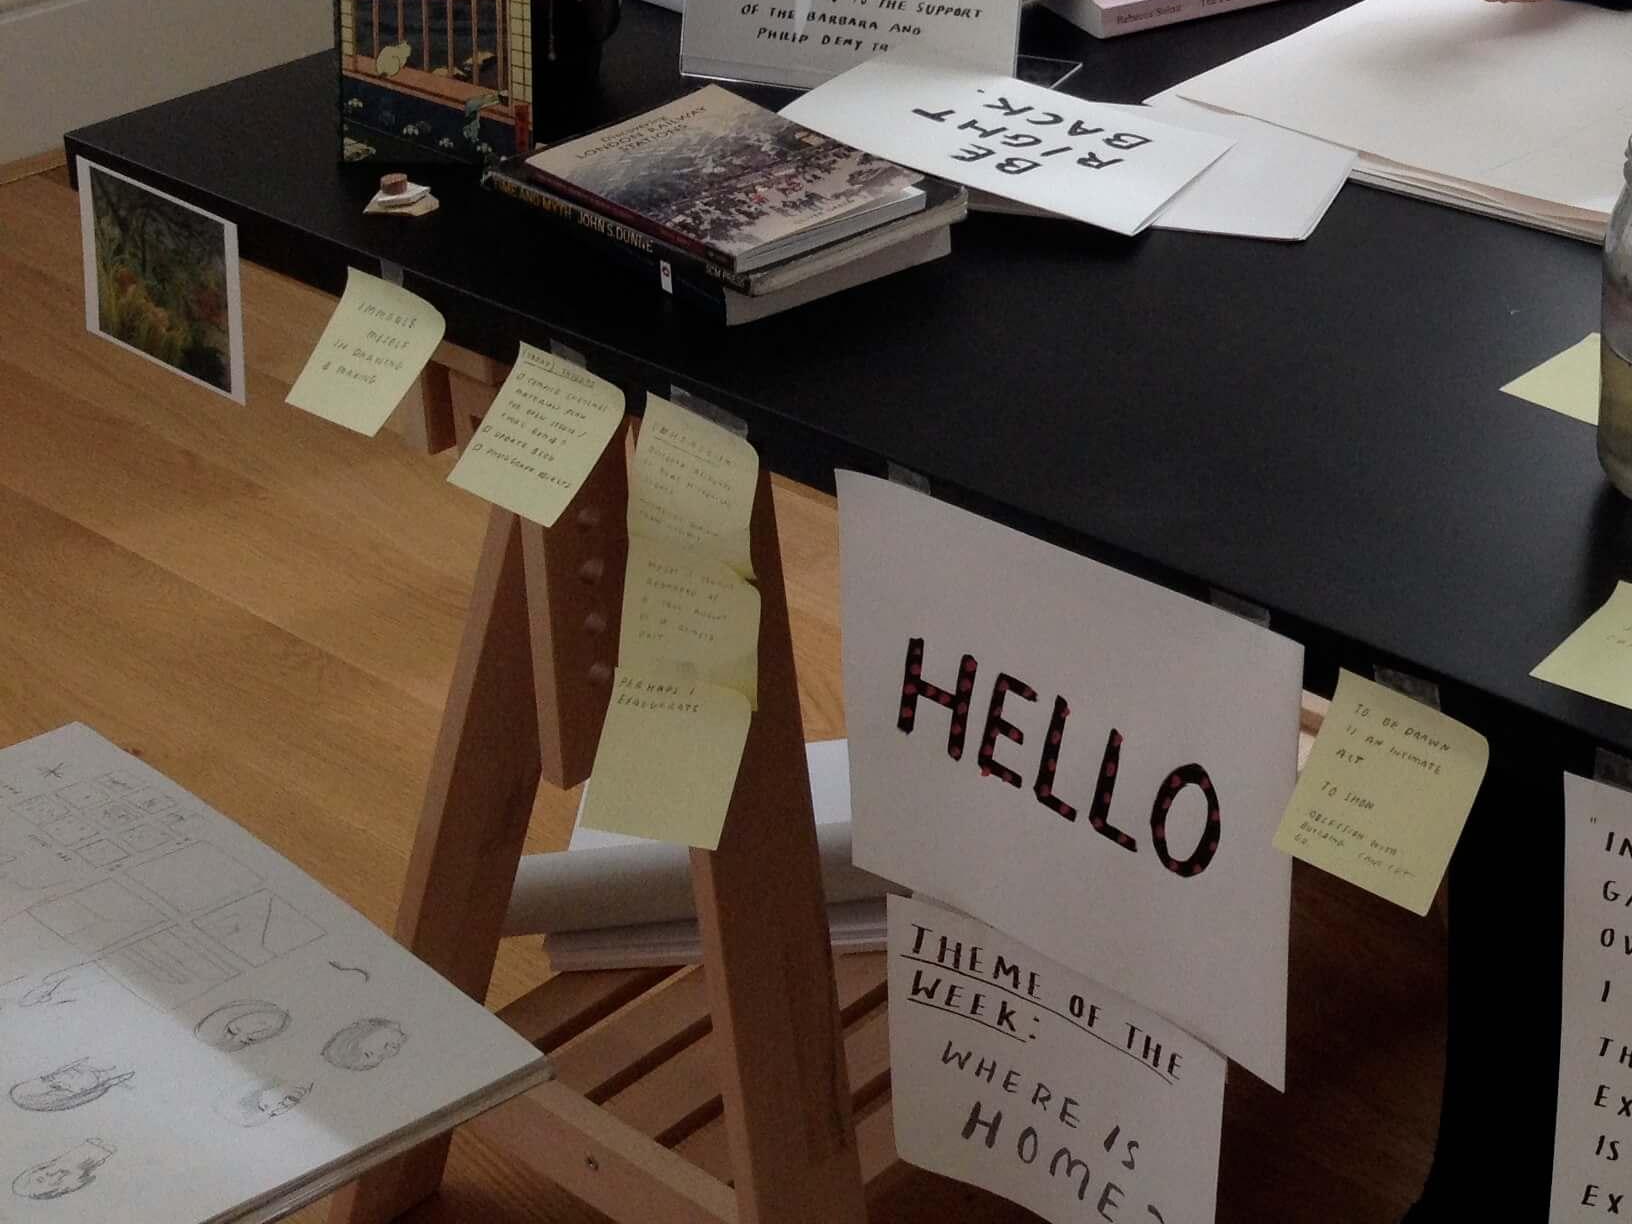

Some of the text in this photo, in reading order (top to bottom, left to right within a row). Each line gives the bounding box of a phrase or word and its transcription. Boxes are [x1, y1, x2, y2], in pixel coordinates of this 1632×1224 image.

[741, 4, 760, 16] OF
[769, 7, 796, 20] THE
[888, 23, 922, 36] AND
[916, 1, 984, 20] SUPPORT
[757, 27, 809, 43] PHILIP
[576, 130, 647, 160] LONDON
[911, 107, 1124, 169] RIGHT
[951, 143, 1042, 175] BE
[577, 208, 605, 234] JOHN
[1404, 727, 1451, 752] DRAWN
[896, 637, 1221, 878] HELLO
[908, 925, 1185, 1080] THEME OF THE
[1600, 980, 1611, 1003] I
[941, 1040, 1140, 1170] WHERE IS
[1595, 1135, 1620, 1161] IS
